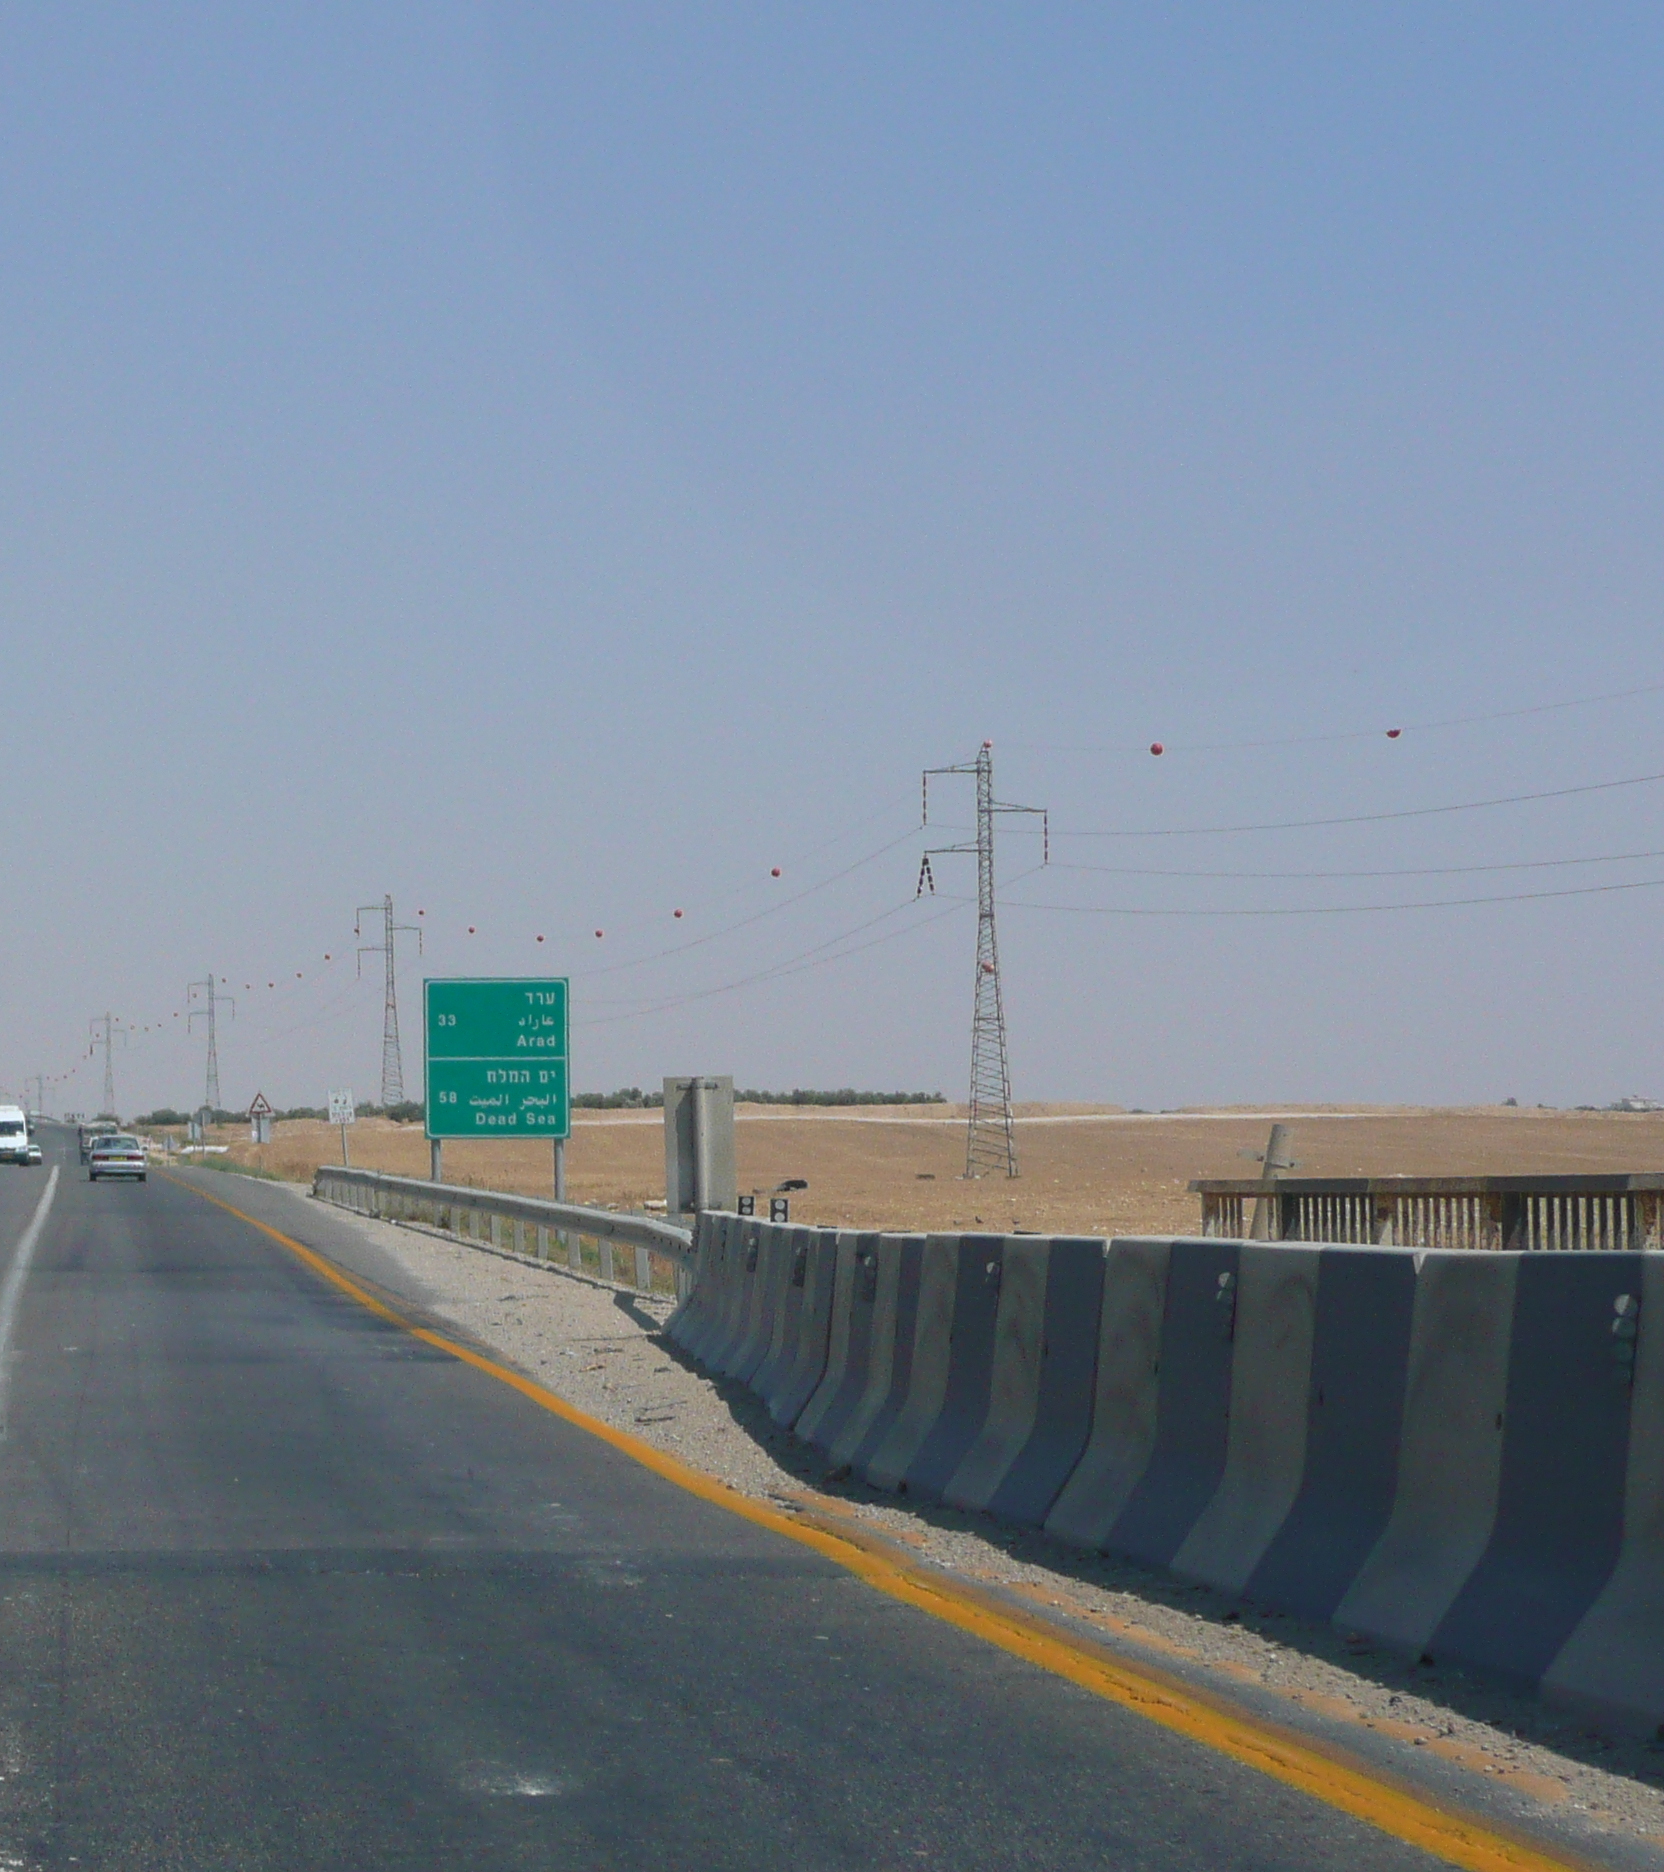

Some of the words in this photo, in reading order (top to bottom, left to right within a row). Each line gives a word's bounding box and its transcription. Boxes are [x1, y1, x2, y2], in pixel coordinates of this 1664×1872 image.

[526, 992, 555, 1005] ערד
[438, 1014, 456, 1026] 33
[517, 1034, 555, 1047] Arad
[487, 1069, 530, 1083] המלח
[539, 1070, 556, 1083] ים
[439, 1091, 457, 1104] 58
[469, 1093, 509, 1108] الميت
[519, 1093, 557, 1110] البحر
[476, 1112, 517, 1125] Dead
[526, 1112, 556, 1125] Sea
